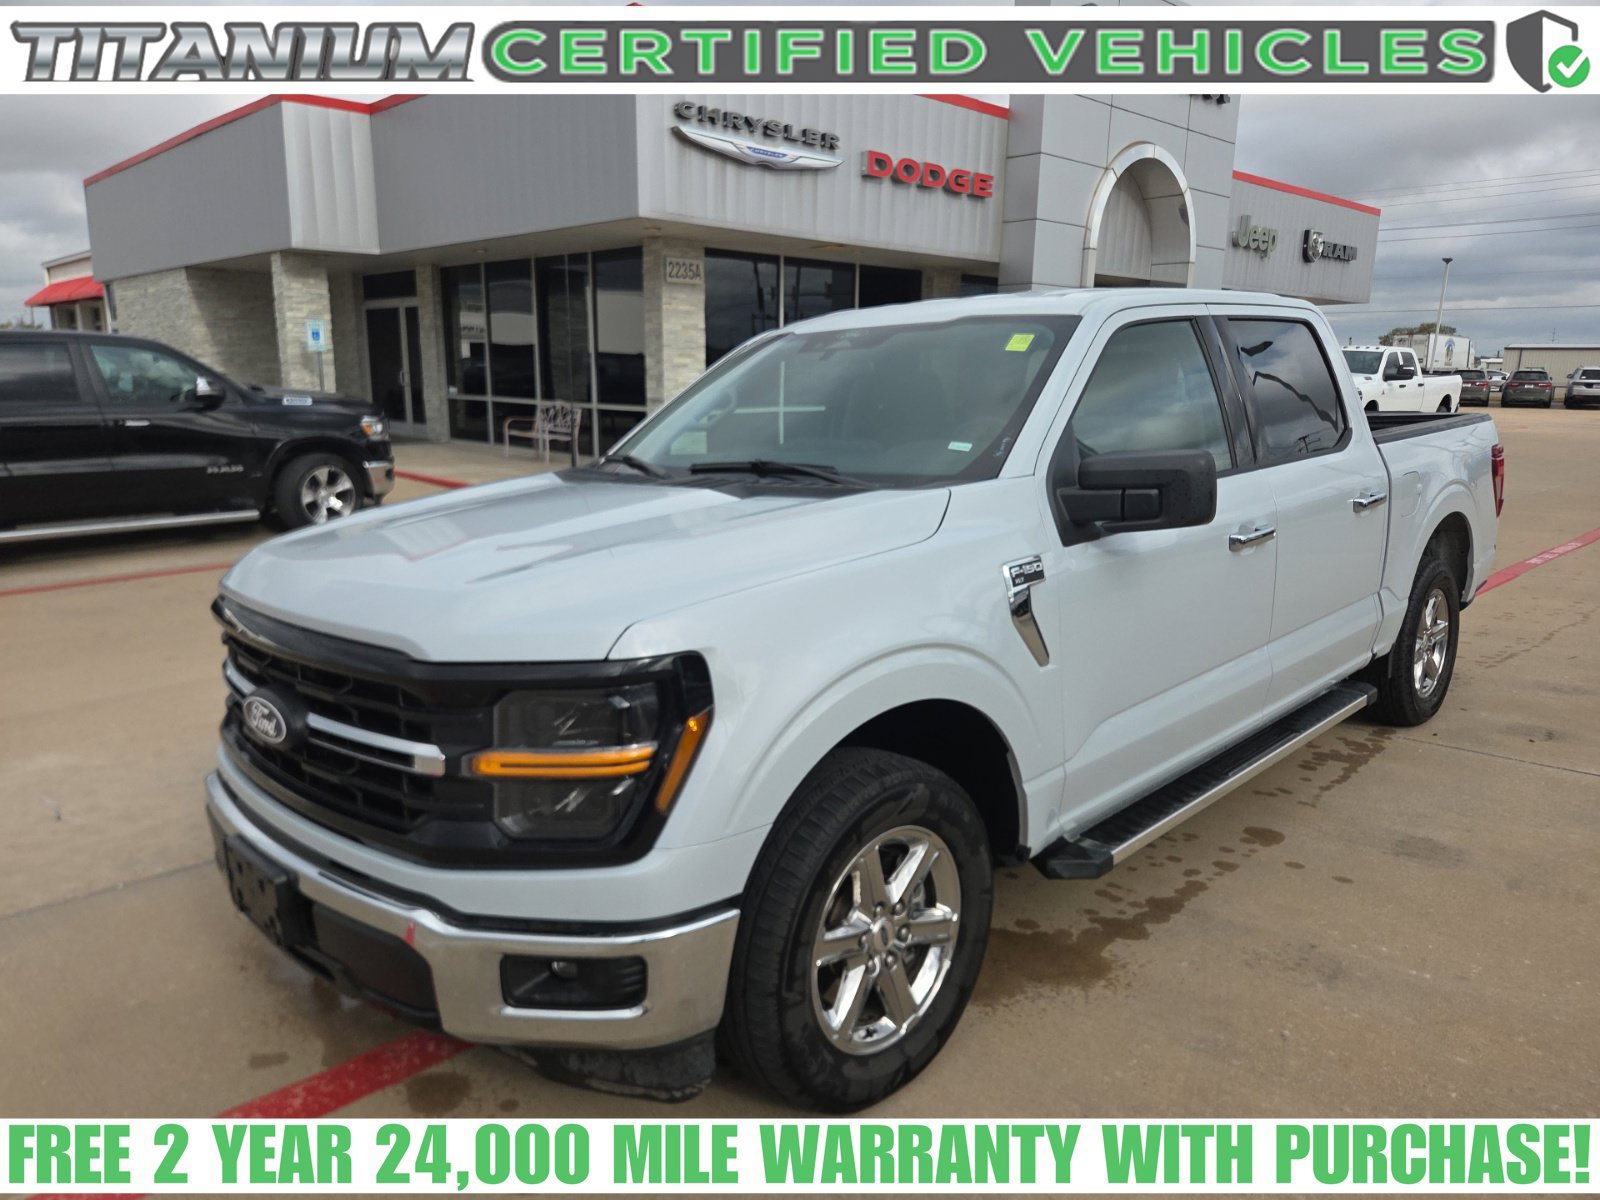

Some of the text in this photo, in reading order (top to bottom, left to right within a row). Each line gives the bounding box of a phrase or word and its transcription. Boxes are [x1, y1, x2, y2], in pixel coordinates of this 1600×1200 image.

[674, 102, 840, 150] CHRYSLER
[864, 150, 994, 199] DODGE
[1232, 215, 1278, 258] Jeep
[1321, 241, 1357, 261] RAM
[668, 261, 702, 280] 2235A
[251, 701, 278, 737] Ford
